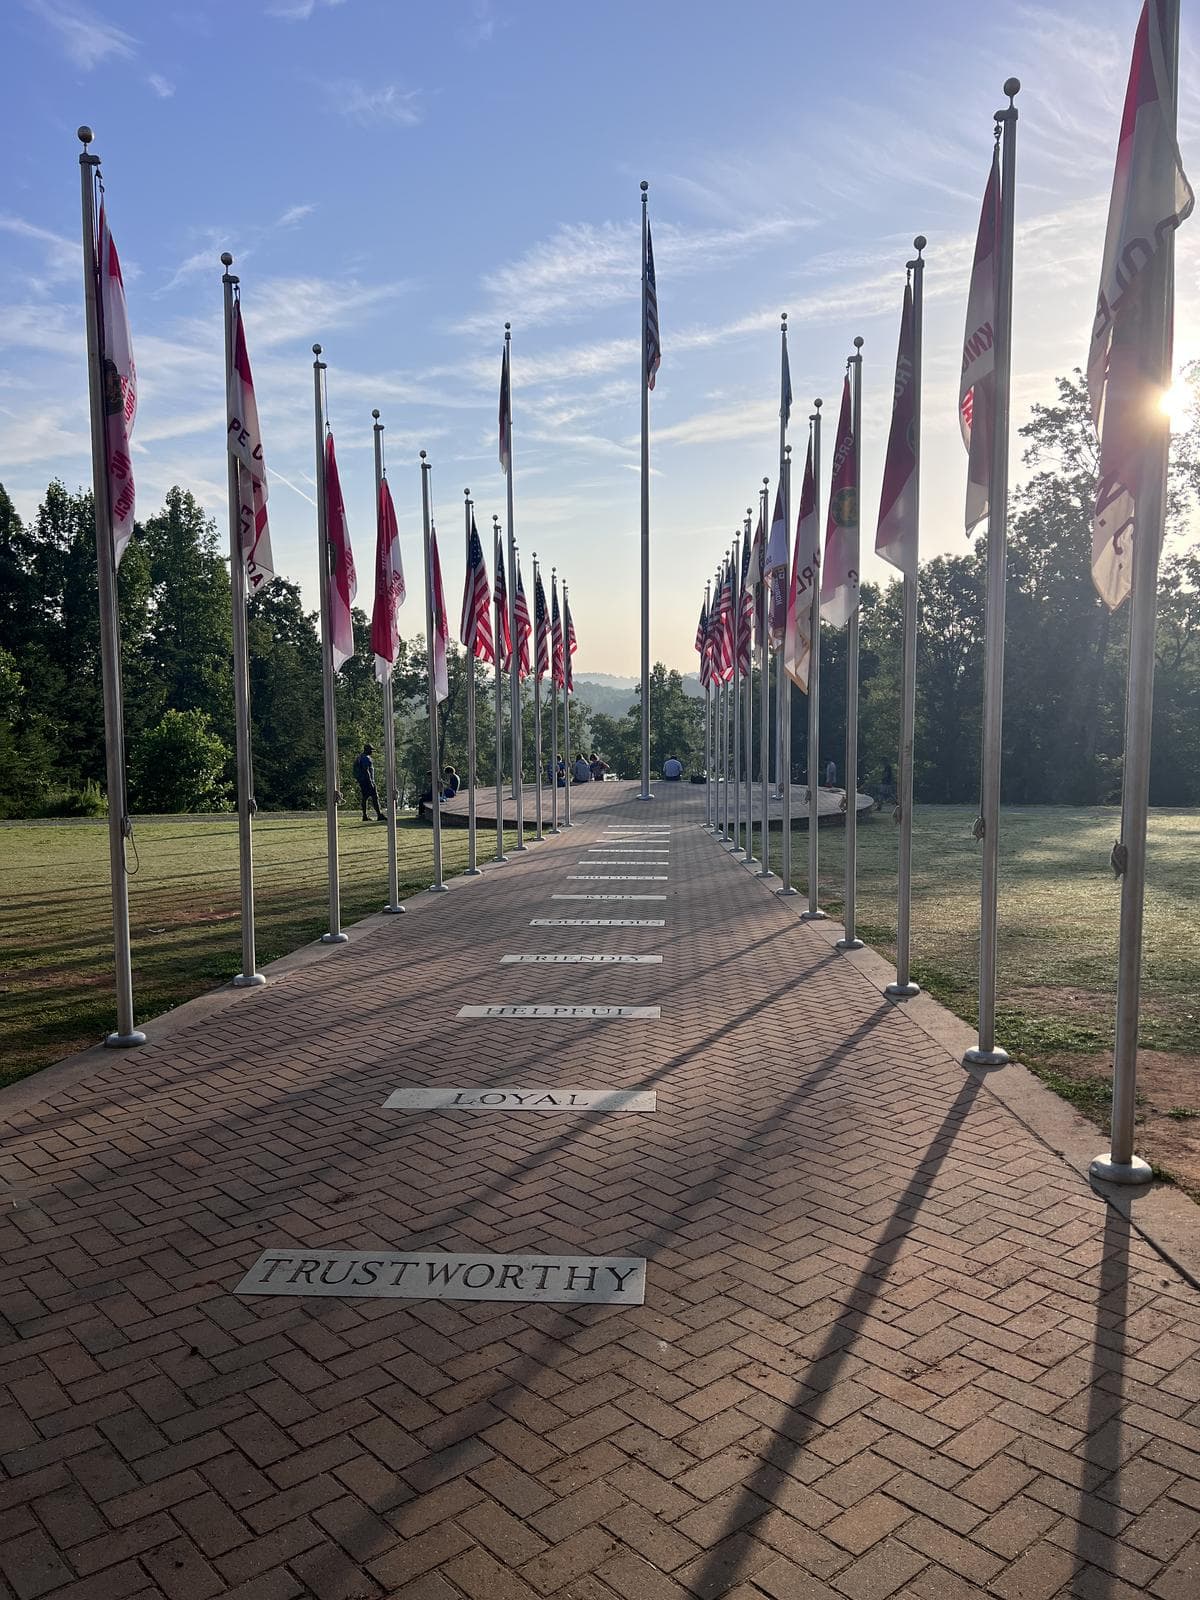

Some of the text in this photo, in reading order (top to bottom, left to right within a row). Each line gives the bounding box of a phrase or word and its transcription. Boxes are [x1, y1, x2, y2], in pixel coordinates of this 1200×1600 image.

[519, 954, 642, 962] FRIENDLY
[485, 1007, 633, 1017] HELPFUL
[453, 1092, 590, 1107] LOYAL
[257, 1257, 639, 1293] TRUSTWORTHY
